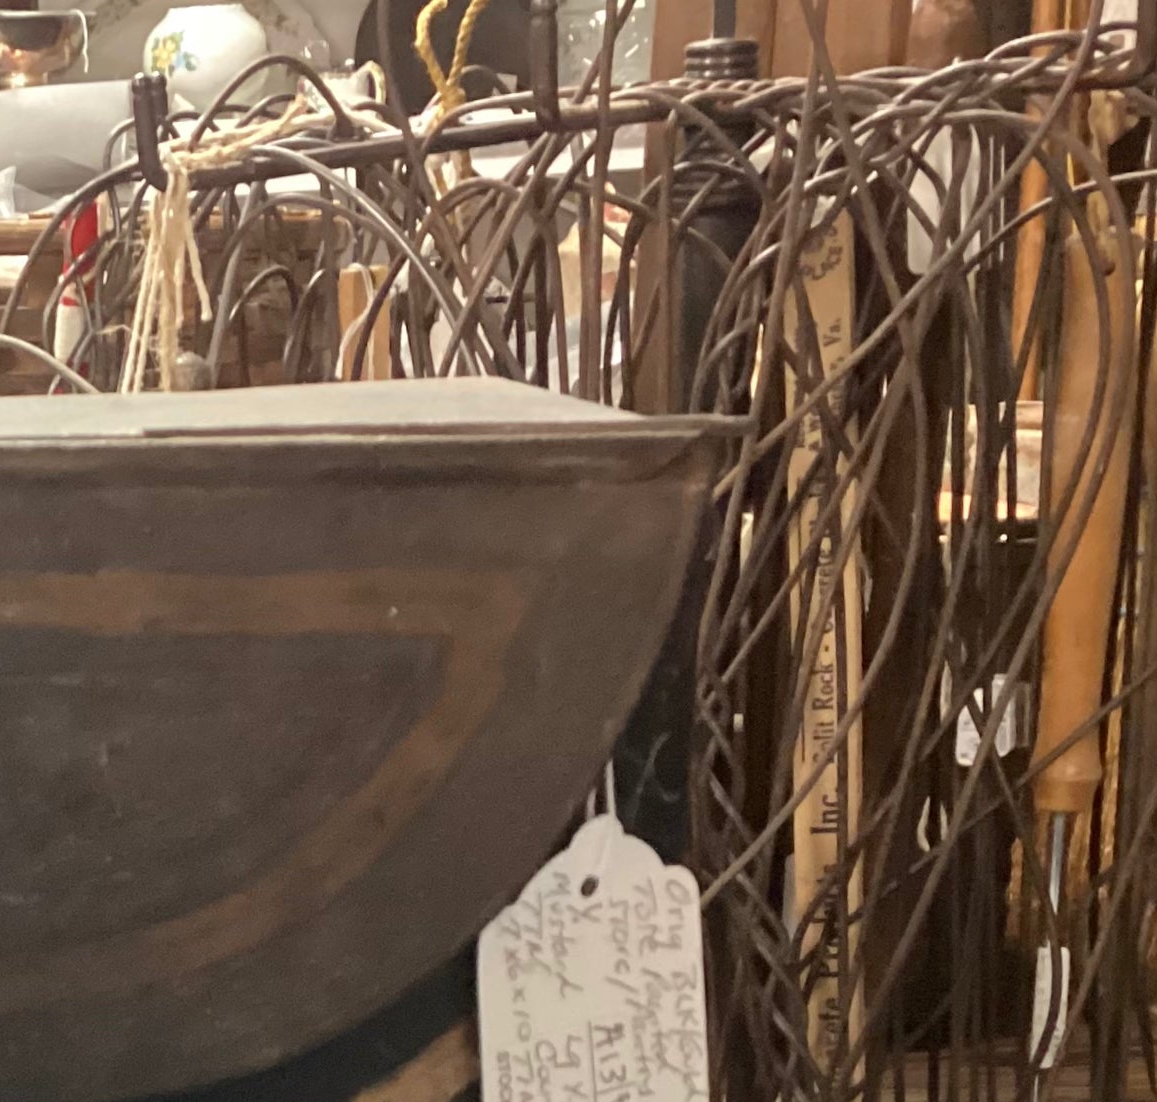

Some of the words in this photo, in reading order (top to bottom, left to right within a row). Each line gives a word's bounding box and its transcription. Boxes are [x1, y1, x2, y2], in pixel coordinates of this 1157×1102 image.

[823, 318, 842, 348] Va.
[810, 662, 834, 710] Rock
[657, 879, 693, 949] Orig
